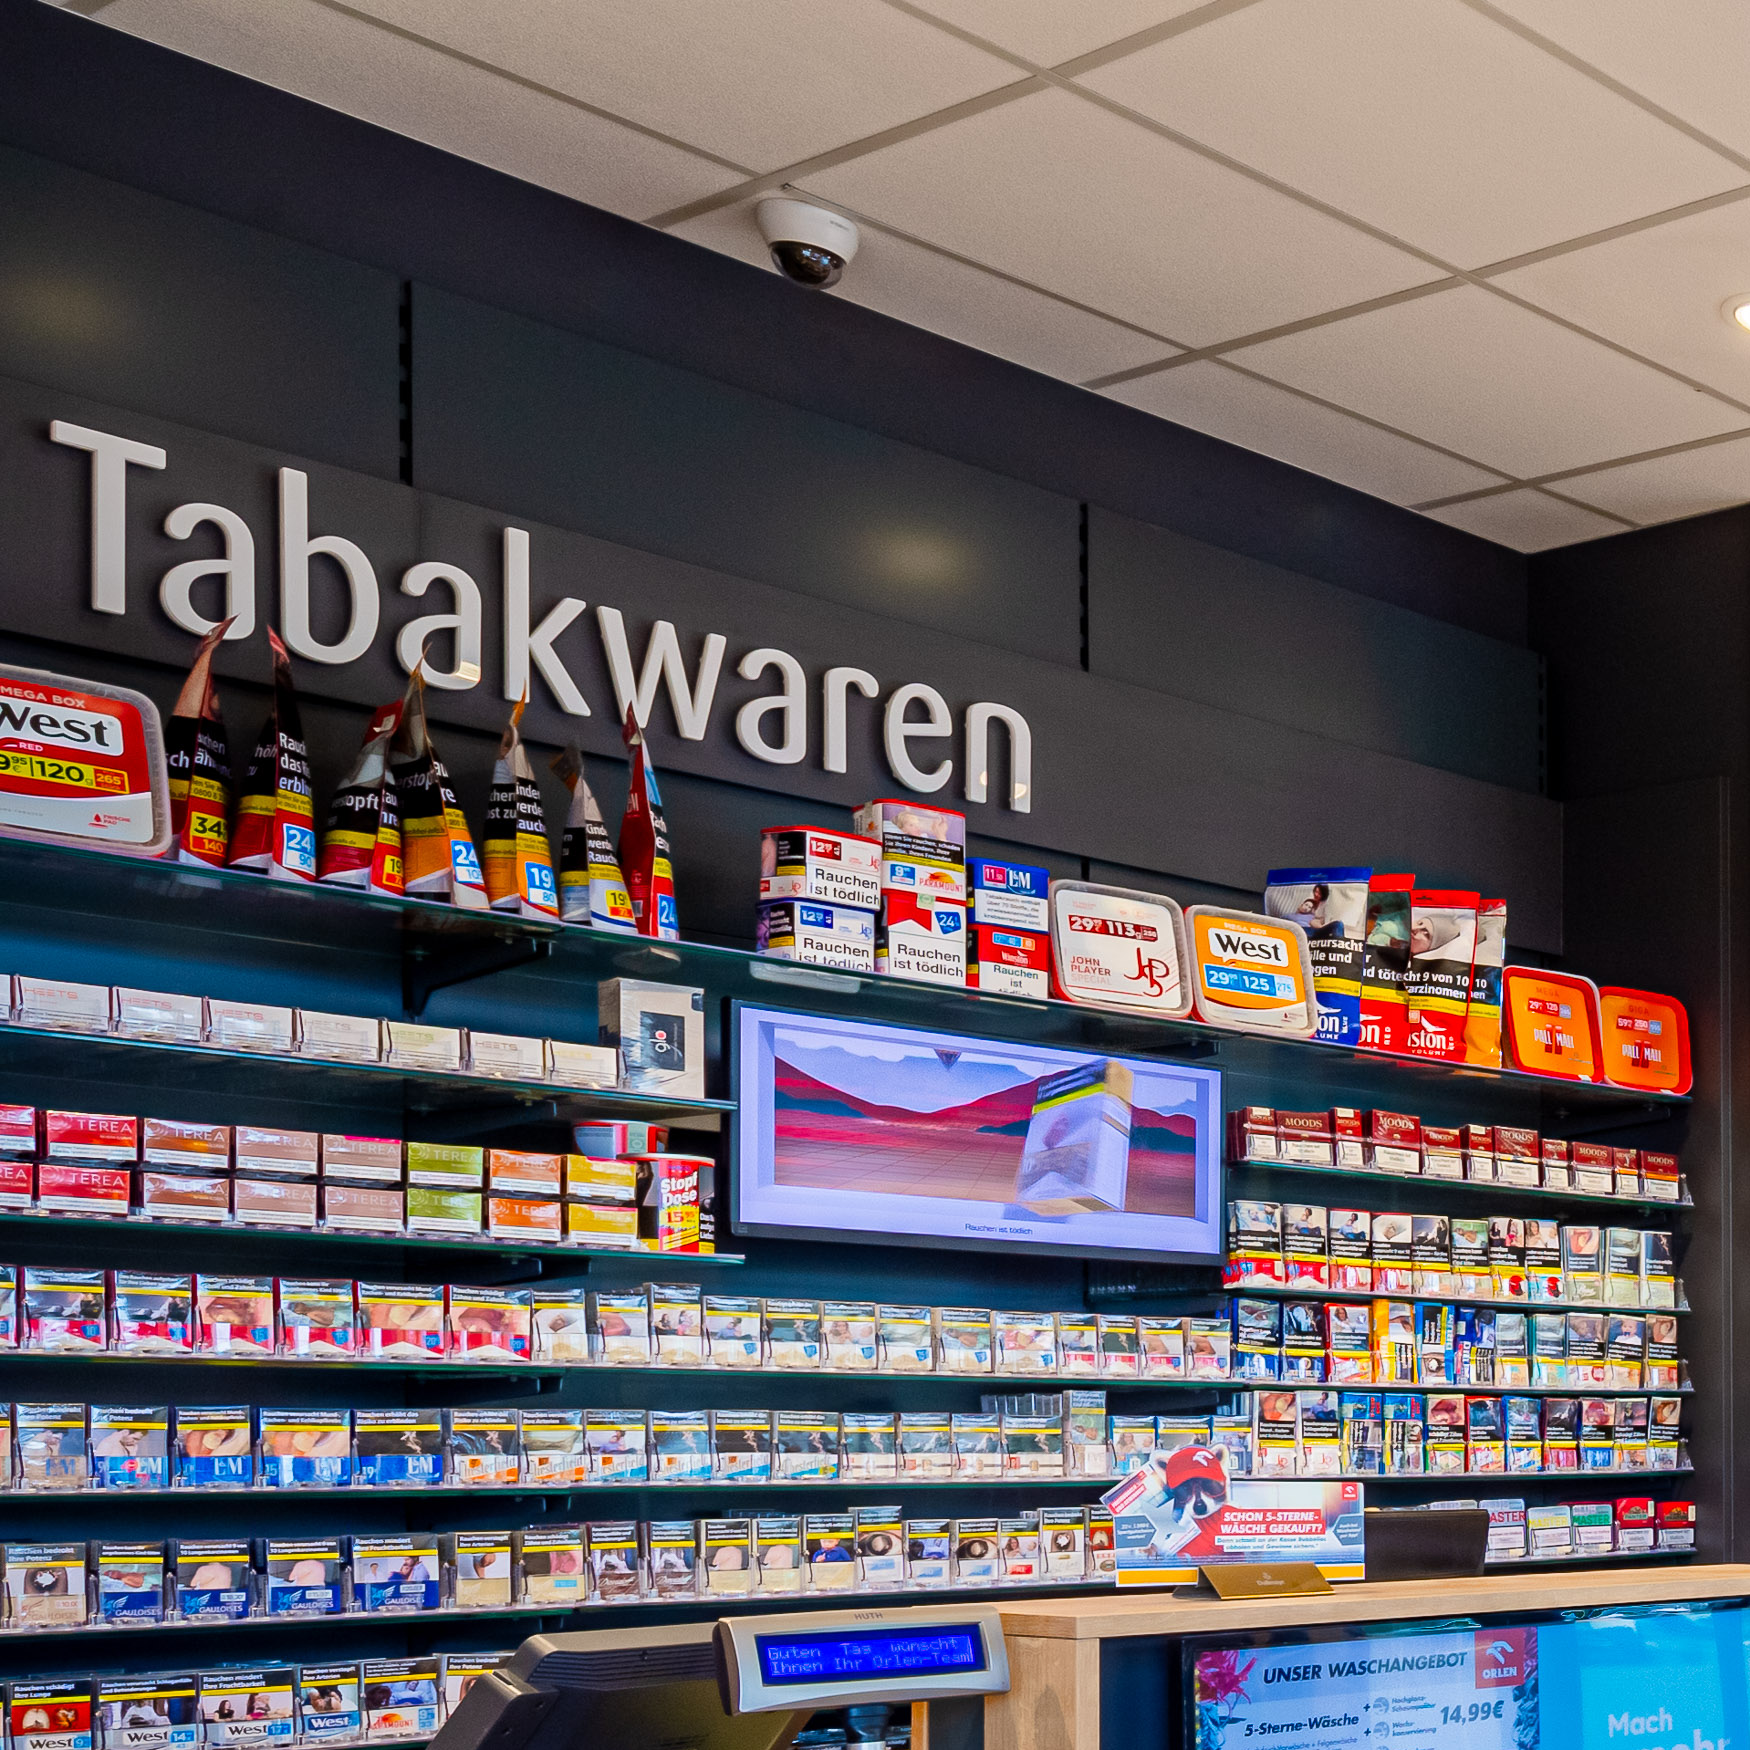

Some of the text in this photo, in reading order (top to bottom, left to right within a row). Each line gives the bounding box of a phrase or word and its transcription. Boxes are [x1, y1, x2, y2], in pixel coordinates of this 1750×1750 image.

[50, 418, 1034, 814] Tabakwaren
[52, 694, 85, 709] BOX
[0, 701, 110, 747] West
[19, 742, 43, 751] RED
[97, 773, 121, 785] 265
[815, 868, 878, 891] Rauchen
[809, 882, 880, 906] ist tödlich
[803, 938, 870, 959] Rauchen
[897, 943, 961, 964] Rauchen
[1215, 932, 1284, 962] West
[1071, 956, 1100, 966] JOHN
[1331, 951, 1352, 963] und
[894, 958, 964, 978] ist tödlich
[1071, 964, 1110, 977] PLAYER
[1071, 972, 1110, 985] SPECIAL
[78, 1119, 132, 1134] TEREA
[1285, 1118, 1323, 1128] MOODS
[173, 1127, 224, 1142] TEREA
[1647, 1155, 1674, 1165] MOODS
[661, 1173, 698, 1195] Stopf
[662, 1190, 697, 1206] Dose
[1224, 1511, 1319, 1522] SCHON 5-STERNE-
[1220, 1521, 1323, 1534] WÄSCHE GEKAUFT?
[115, 1606, 162, 1617] GAULOISES
[199, 1602, 243, 1614] GAULOISES
[854, 1612, 884, 1621] HUTH
[767, 1644, 821, 1663] Guten
[771, 1659, 824, 1674] Ihnen
[834, 1655, 864, 1672] Ihr
[1263, 1652, 1468, 1684] UNSER WASCHANGEBOT
[1482, 1666, 1517, 1679] ORLEN
[1440, 1701, 1504, 1726] 14,99€
[228, 1722, 268, 1737] West
[1244, 1713, 1359, 1738] 5-Sterne-Wäsche
[1608, 1707, 1673, 1737] Mach
[29, 1737, 74, 1750] West
